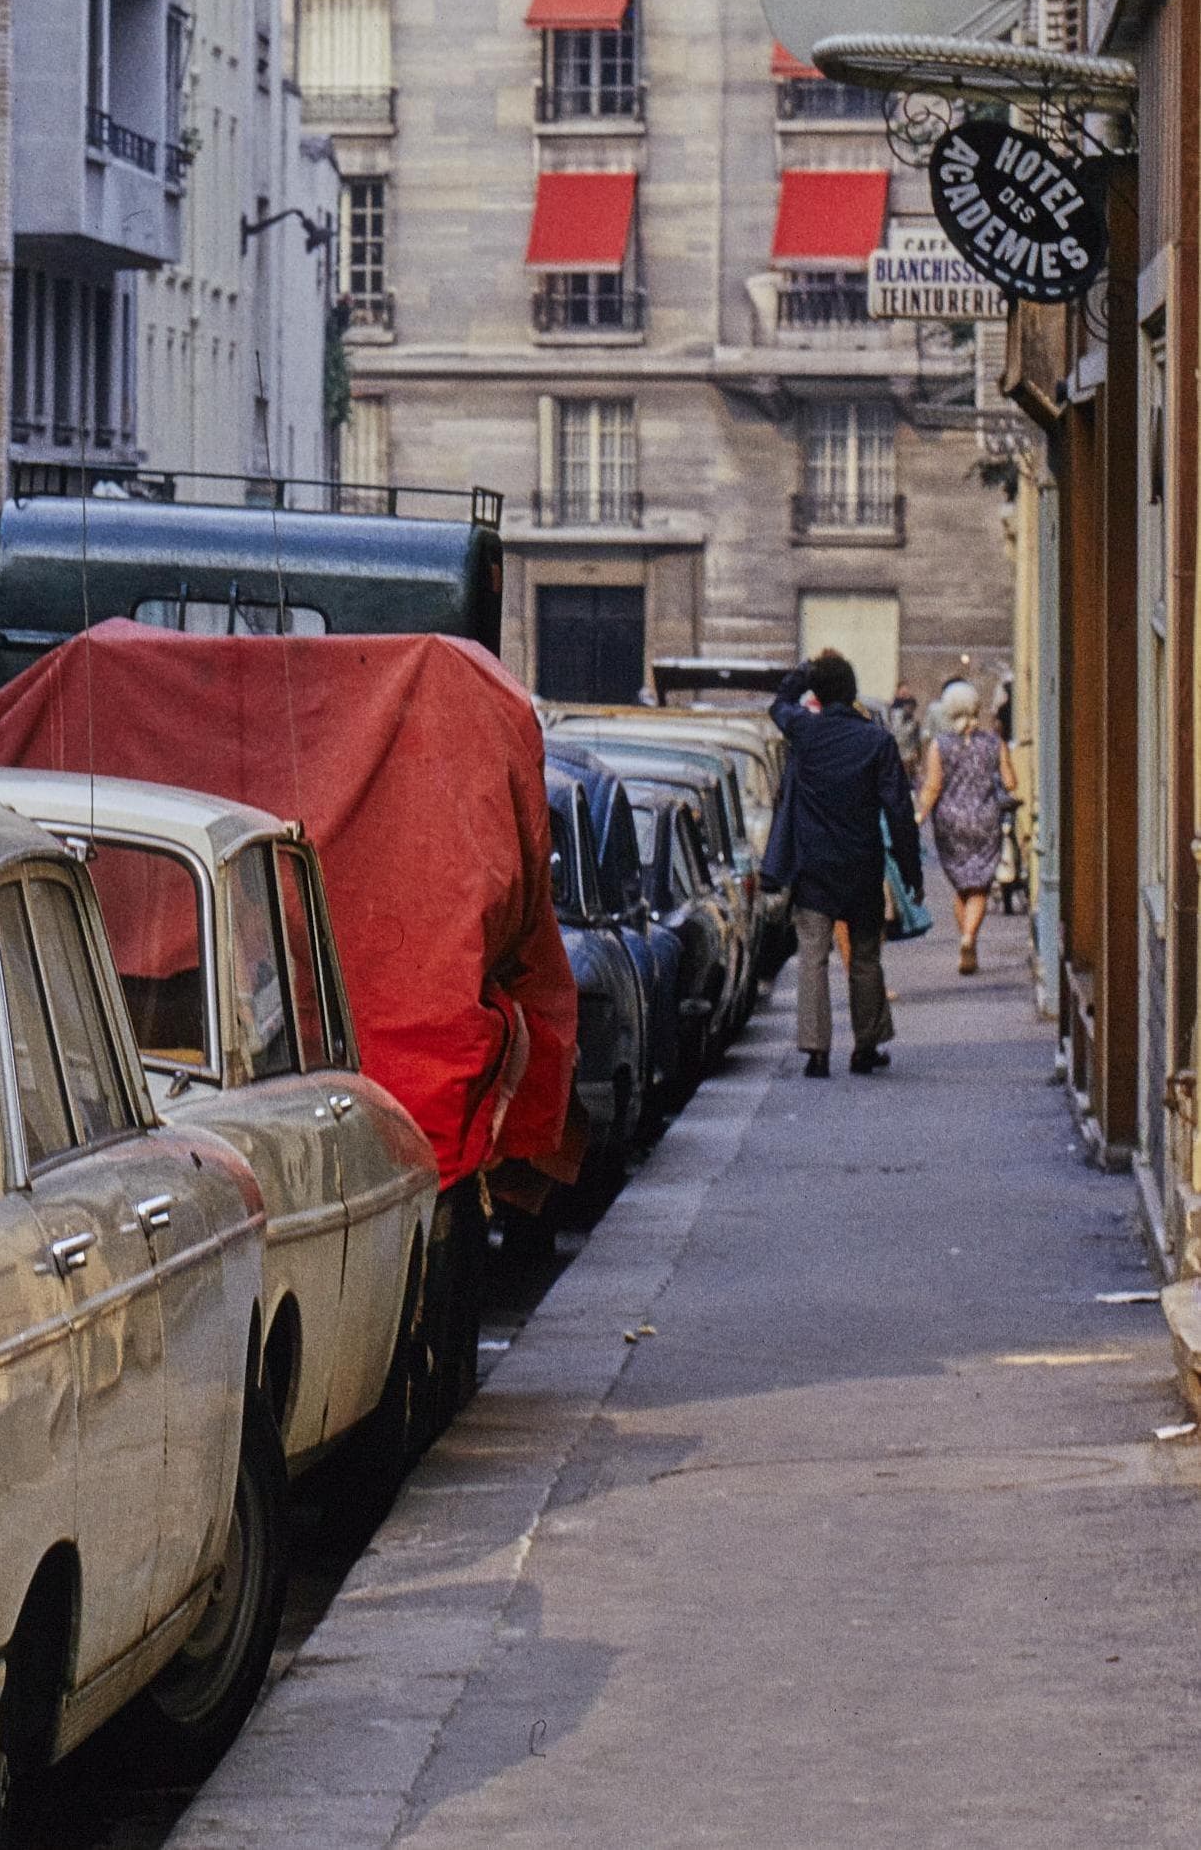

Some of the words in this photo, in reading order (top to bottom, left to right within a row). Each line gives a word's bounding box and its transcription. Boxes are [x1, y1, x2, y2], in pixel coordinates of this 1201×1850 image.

[940, 134, 1089, 280] ACADEMIES
[994, 135, 1085, 231] HOTEL
[998, 186, 1037, 224] DES
